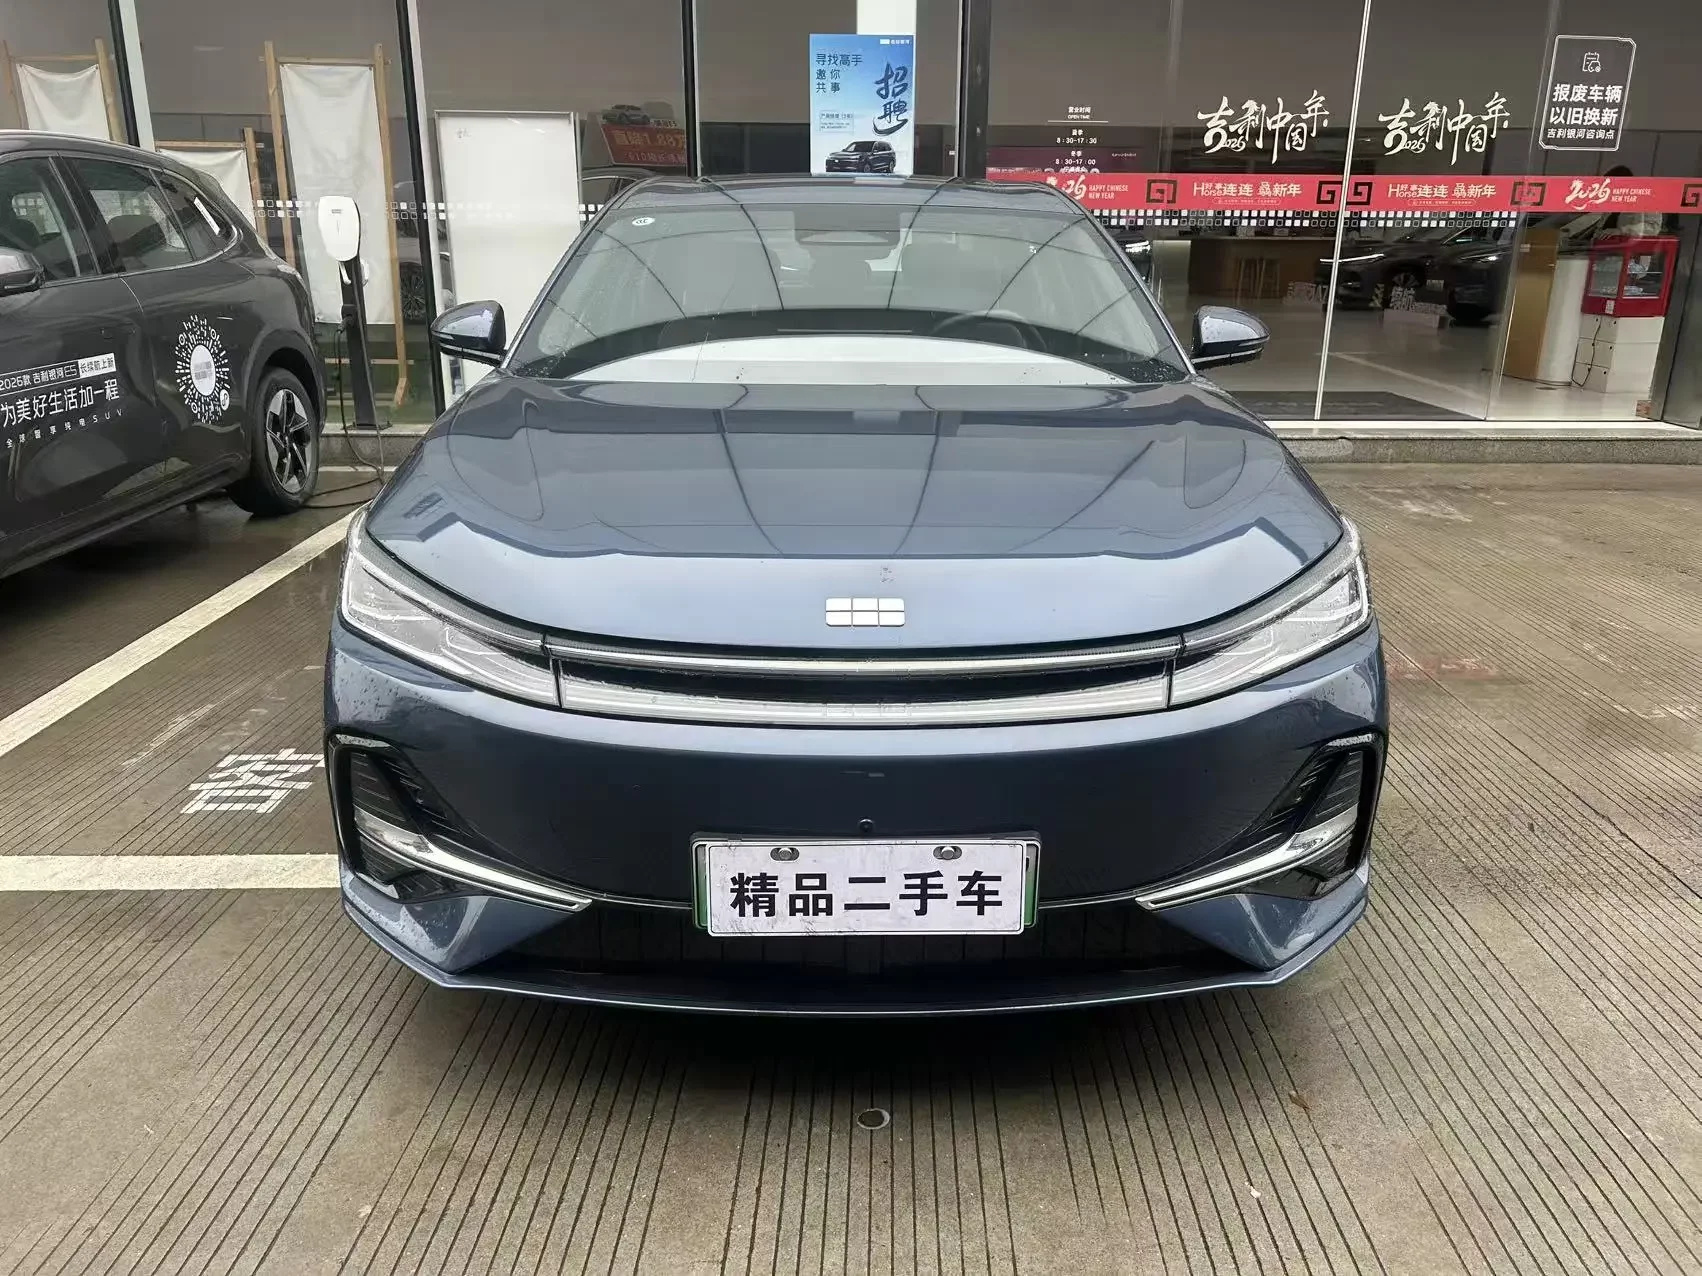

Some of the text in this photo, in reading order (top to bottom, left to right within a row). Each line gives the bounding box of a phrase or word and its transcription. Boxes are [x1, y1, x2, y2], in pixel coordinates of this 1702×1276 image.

[816, 53, 862, 67] 寻找高手
[816, 68, 841, 80] 邀你
[816, 82, 841, 94] 共事
[1552, 84, 1623, 103] 报废车辆
[873, 61, 909, 136] 招聘
[1549, 106, 1619, 126] 以旧换新
[1197, 90, 1330, 164] 吉利中国年
[1378, 91, 1511, 165] 吉利中国年
[1547, 128, 1615, 140] 吉利银河咨询点
[1088, 184, 1129, 192] HAPPY CHINESE
[1088, 192, 1115, 200] NEW YEAR
[1630, 188, 1652, 196] CHINESE
[0, 374, 31, 391] 2026款
[0, 379, 119, 428] 为美好生活加一程
[729, 870, 1003, 918] 精品二手车
